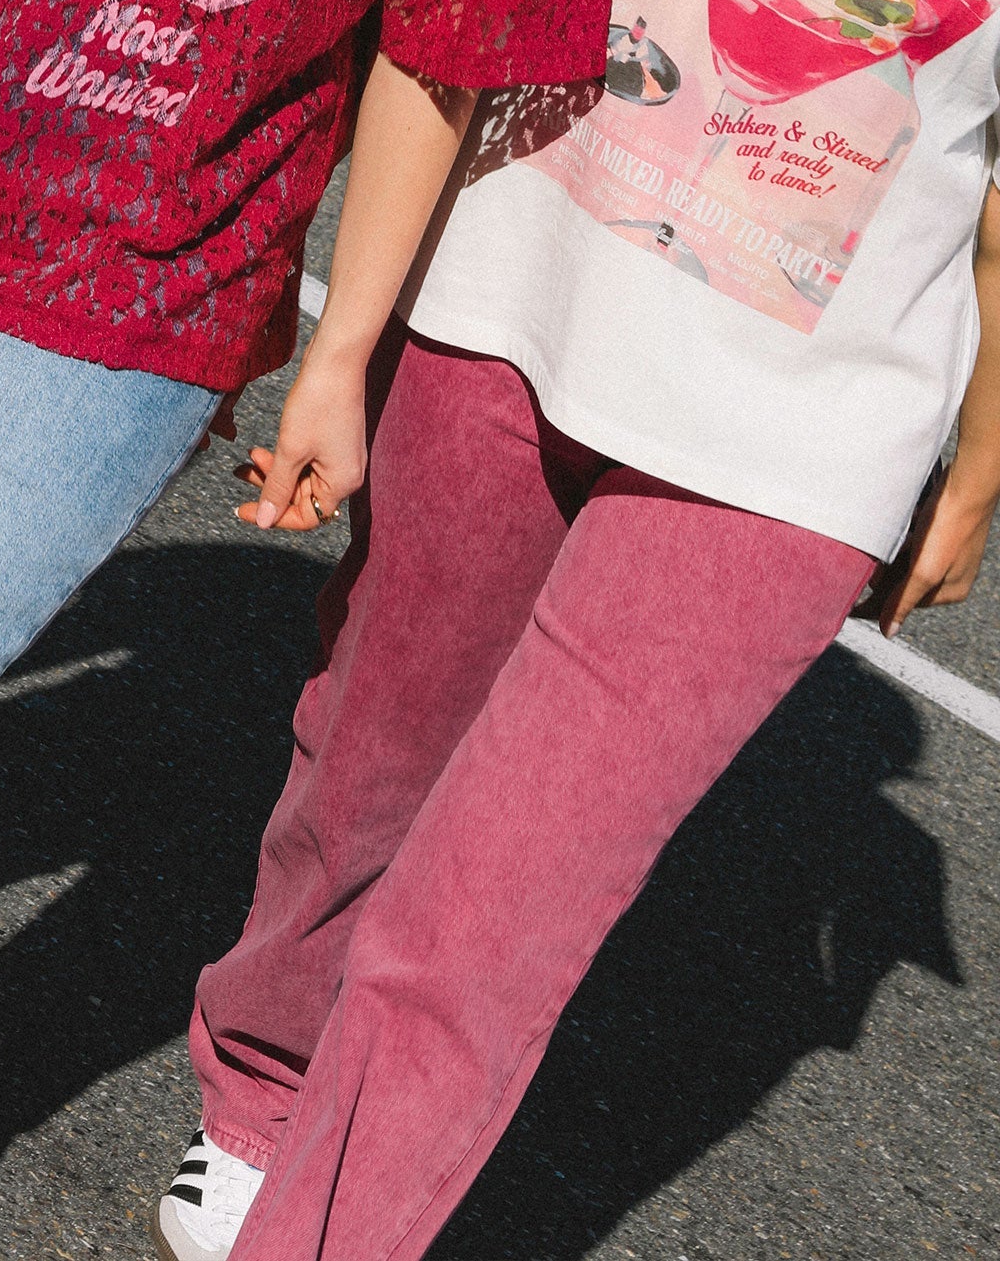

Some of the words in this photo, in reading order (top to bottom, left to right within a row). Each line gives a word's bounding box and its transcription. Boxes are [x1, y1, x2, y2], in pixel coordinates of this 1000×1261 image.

[25, 52, 200, 128] Wanted
[703, 112, 779, 137] Shaken
[784, 120, 807, 142] &
[812, 130, 890, 173] Stirred
[736, 140, 776, 159] and
[776, 155, 834, 180] ready
[747, 161, 766, 181] to
[770, 167, 837, 199] dance!
[598, 140, 665, 201] MIXED,
[665, 177, 736, 235] READY
[732, 211, 764, 253] TO
[759, 233, 838, 287] PARTY
[726, 251, 770, 280] MOJITO
